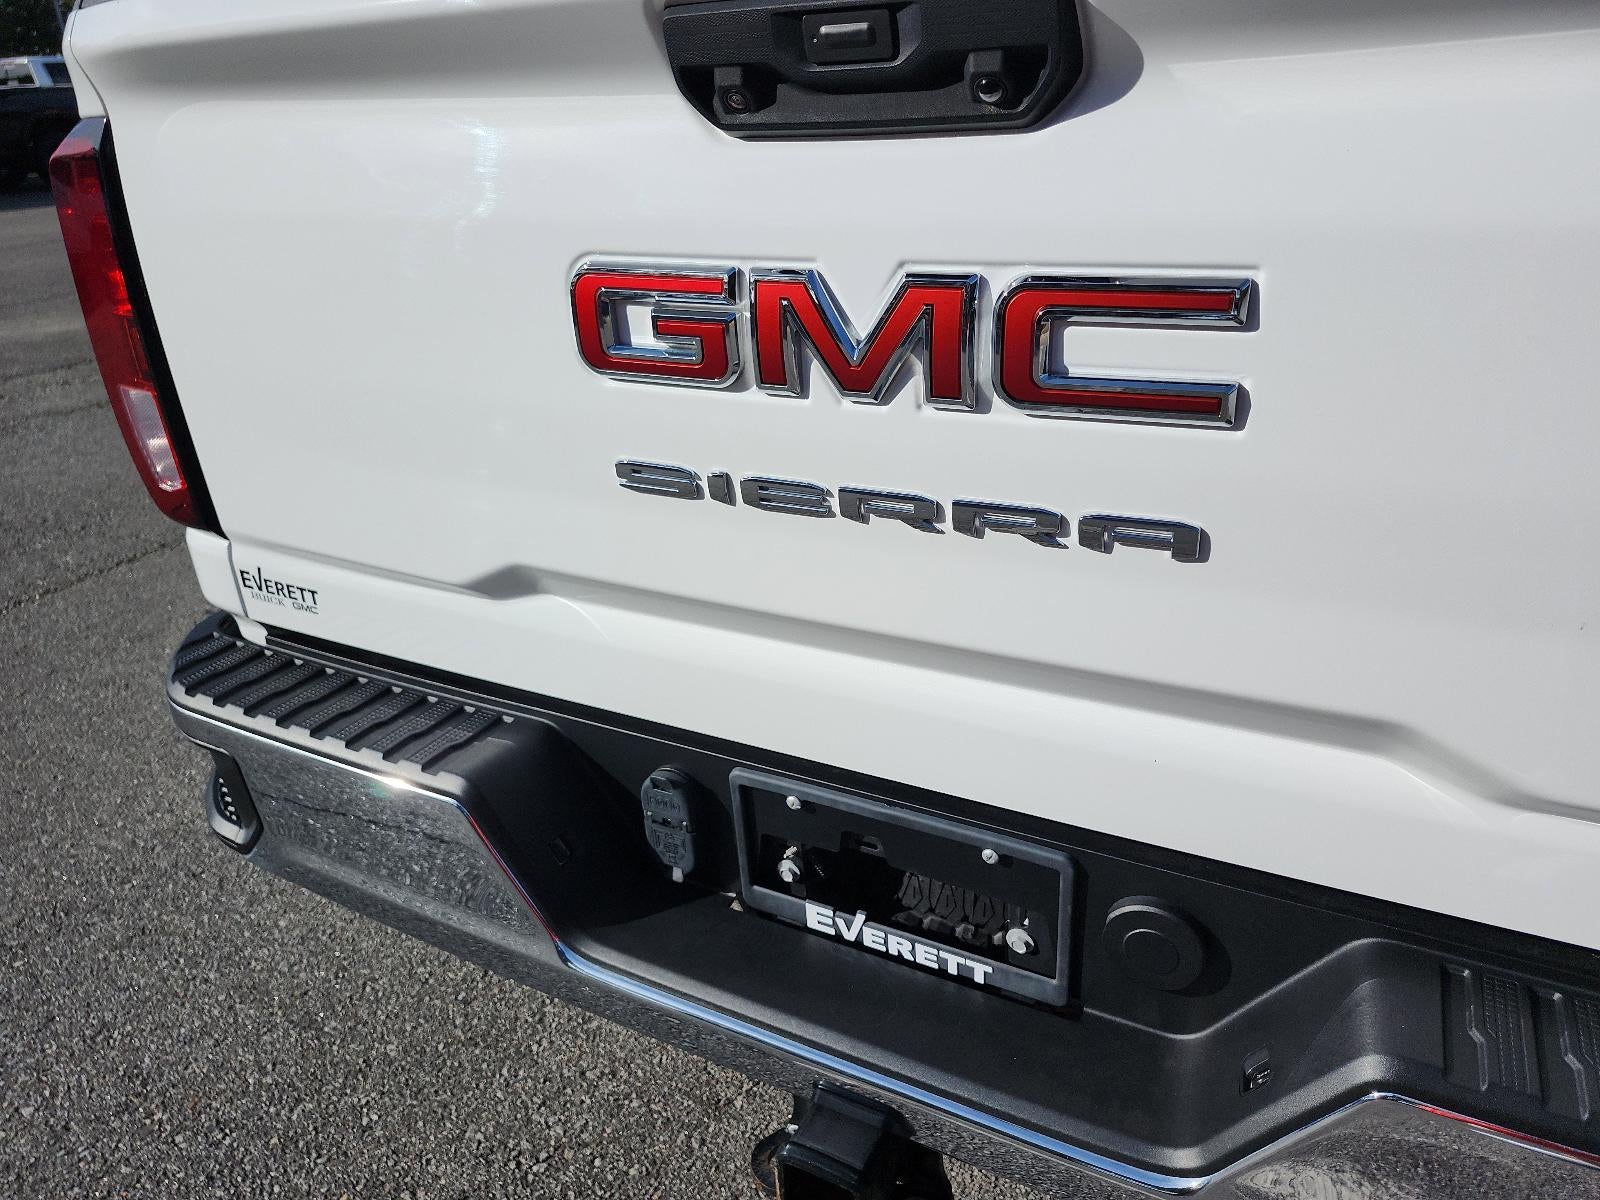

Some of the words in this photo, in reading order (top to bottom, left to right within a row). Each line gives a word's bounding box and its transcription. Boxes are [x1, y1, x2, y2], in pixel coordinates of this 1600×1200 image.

[570, 261, 1253, 429] GMC
[614, 459, 1207, 562] SIERRA
[239, 566, 319, 606] EVERETT
[292, 601, 319, 615] GMC
[805, 900, 993, 984] EVERETT
